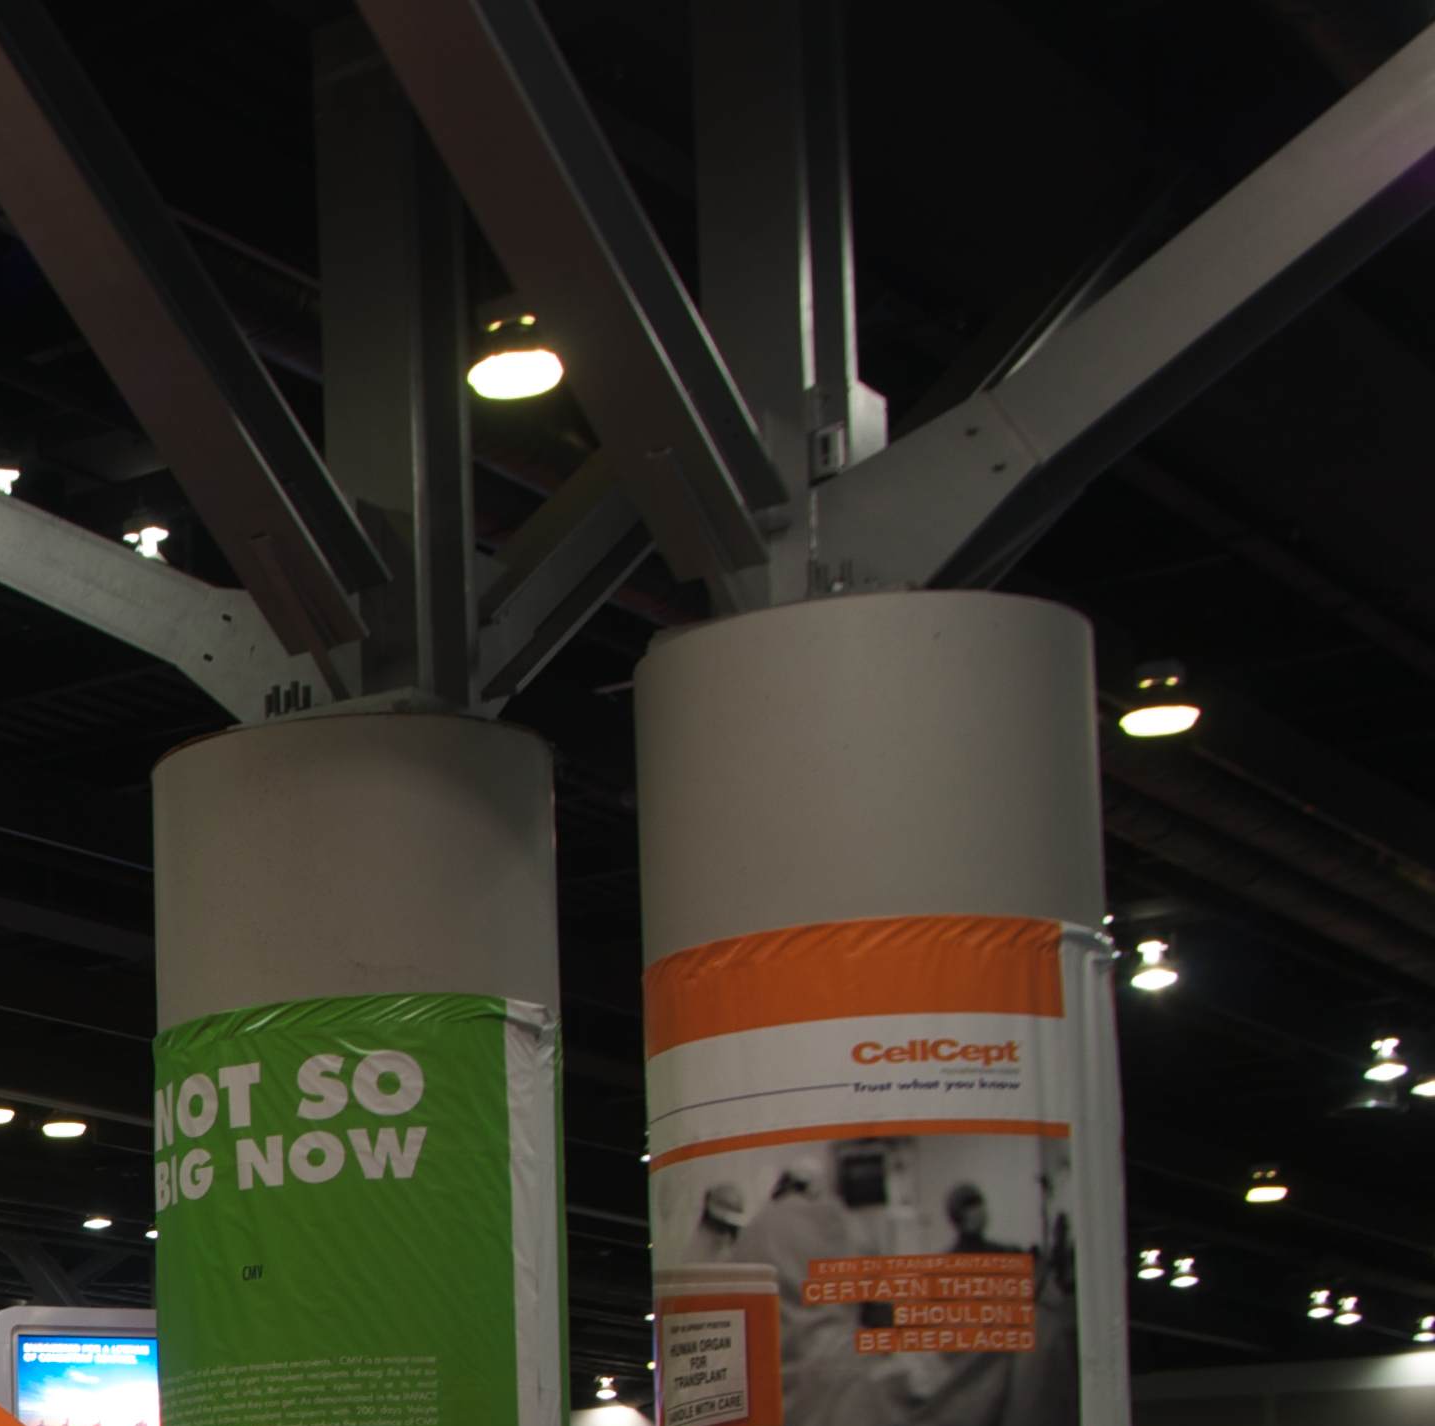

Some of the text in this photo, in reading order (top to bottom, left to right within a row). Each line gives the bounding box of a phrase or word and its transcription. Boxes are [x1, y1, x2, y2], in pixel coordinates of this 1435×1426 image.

[852, 1039, 1020, 1066] CellCept
[853, 1082, 892, 1092] Trust
[945, 1080, 974, 1091] you
[979, 1078, 1020, 1089] know
[156, 1049, 425, 1152] NOT SO
[156, 1126, 427, 1213] BIG NOW
[818, 1262, 858, 1274] EVEN
[805, 1277, 1033, 1301] CERTAIN THINGS
[858, 1330, 1033, 1350] BE REPLACED
